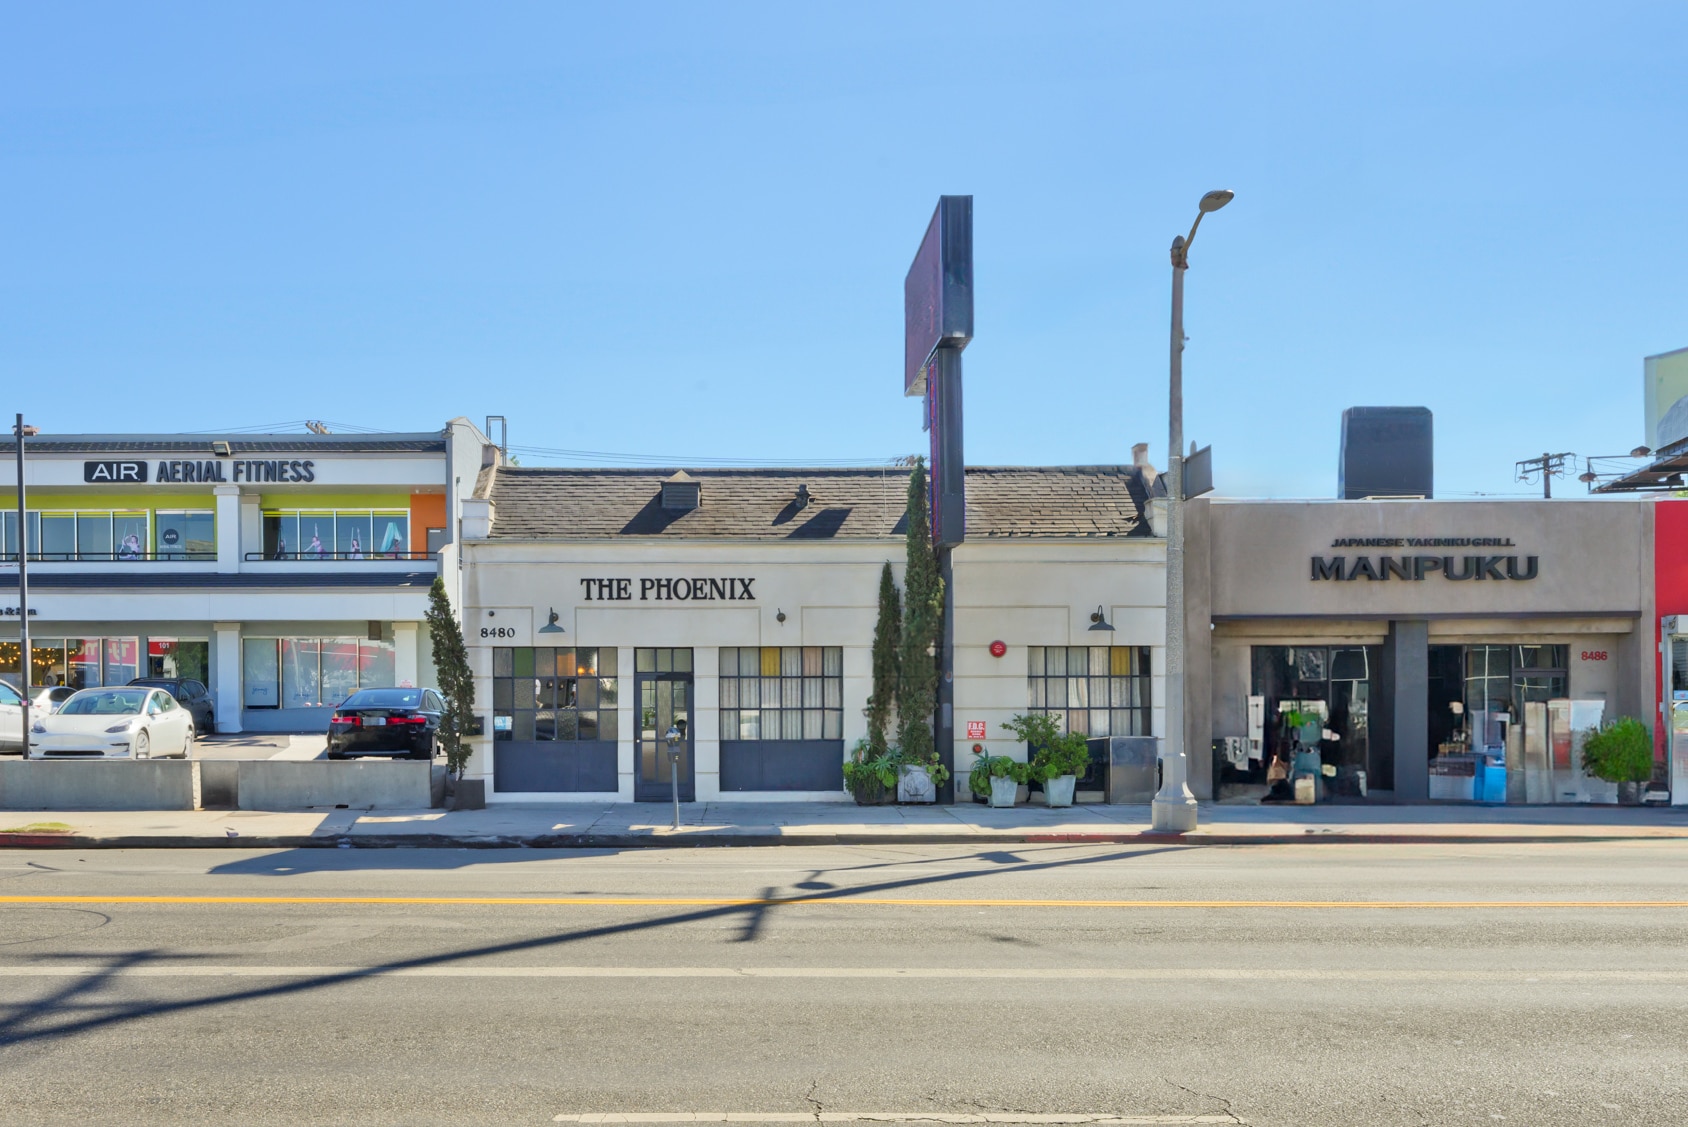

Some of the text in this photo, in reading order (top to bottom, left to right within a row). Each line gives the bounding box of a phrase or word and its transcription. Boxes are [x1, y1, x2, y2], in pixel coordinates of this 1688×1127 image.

[92, 461, 315, 483] AIR AERIAL FITNESS
[1331, 538, 1516, 547] JAPANESE YAKINIKU GRILL
[1310, 555, 1539, 581] MANPUKU
[580, 578, 756, 600] THE PHOENIX
[480, 627, 515, 638] 8480
[1581, 651, 1608, 661] 8486
